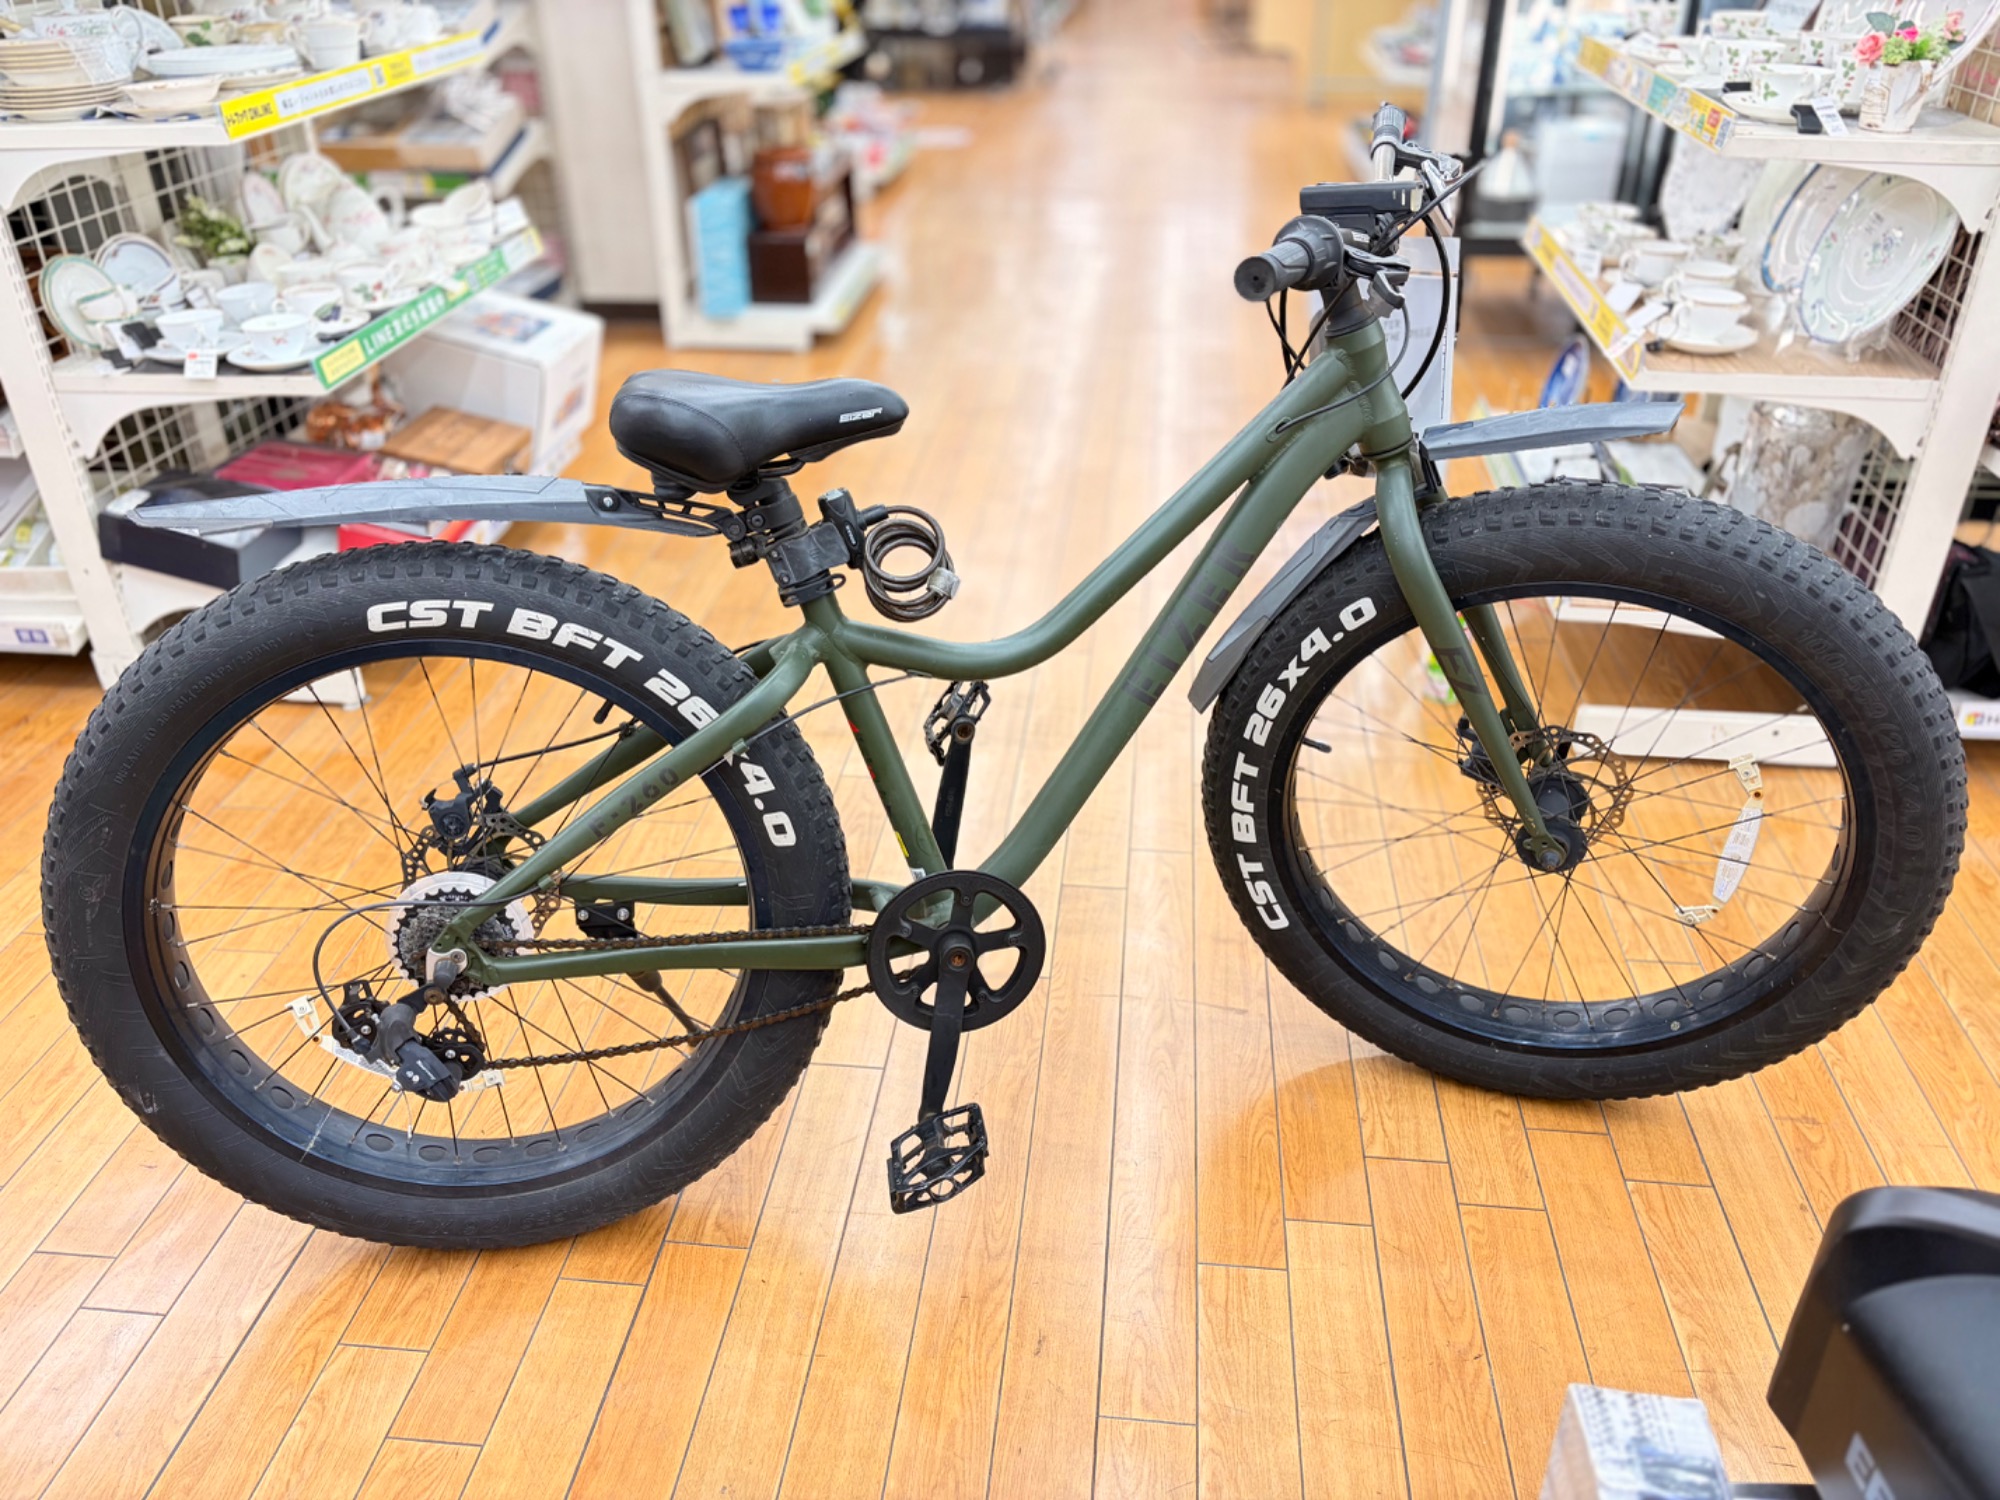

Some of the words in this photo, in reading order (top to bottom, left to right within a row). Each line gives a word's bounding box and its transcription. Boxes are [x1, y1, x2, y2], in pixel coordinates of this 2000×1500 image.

[367, 600, 494, 634] CST
[506, 608, 643, 670] BFT
[588, 766, 680, 839] F-260
[1231, 752, 1259, 844] BFT
[1238, 853, 1290, 932] CST
